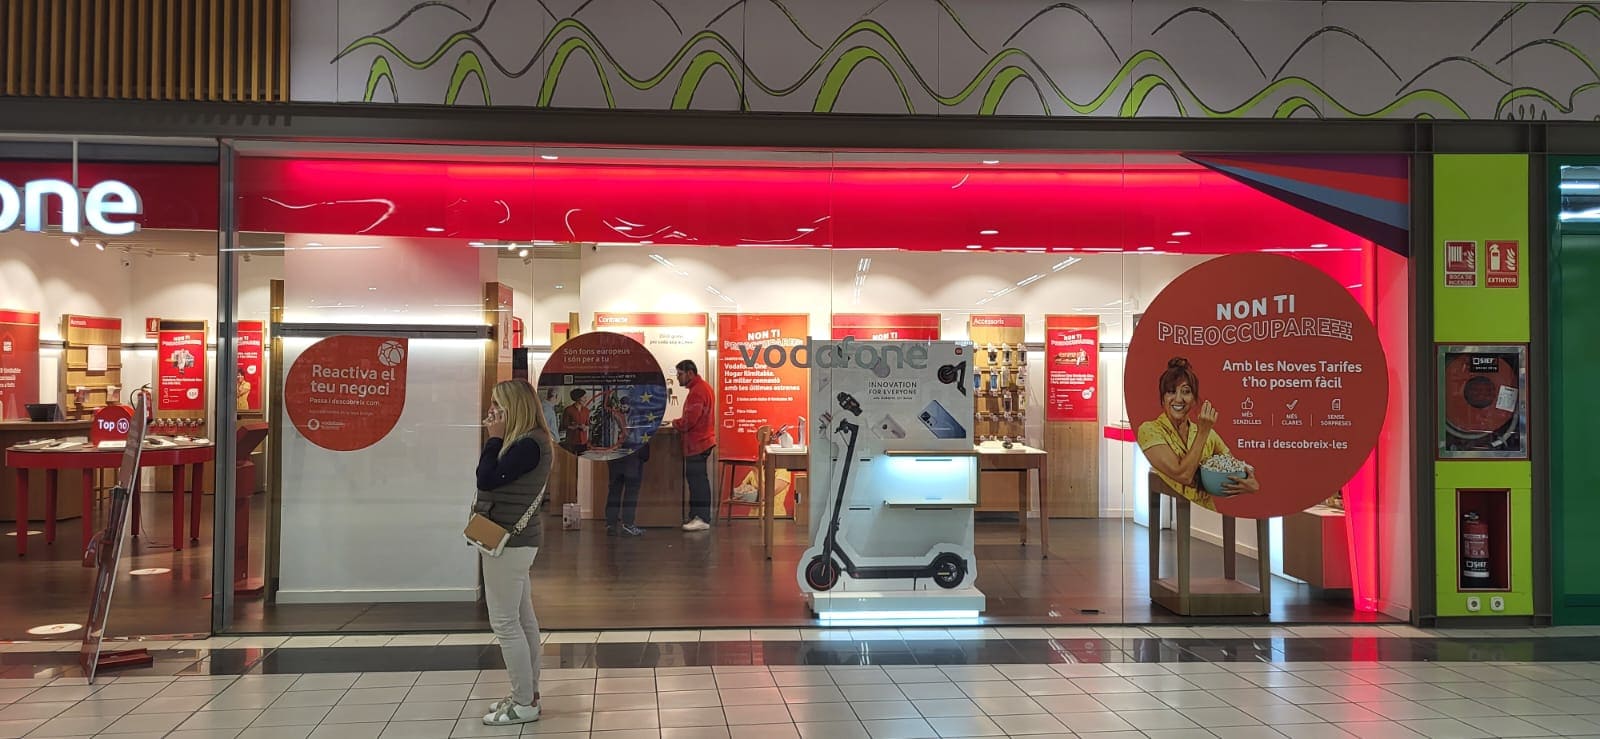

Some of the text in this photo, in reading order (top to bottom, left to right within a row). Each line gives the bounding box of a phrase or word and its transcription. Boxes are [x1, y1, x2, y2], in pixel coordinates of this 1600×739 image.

[1216, 294, 1295, 321] NON TI
[748, 329, 780, 341] NON TI
[739, 336, 928, 370] vodafone
[312, 364, 395, 381] Reactiva el
[1222, 360, 1362, 373] Amb les Noves Tarifes
[311, 380, 389, 397] teu negoci
[1270, 378, 1313, 390] posem
[1315, 376, 1342, 388] fàcil
[332, 398, 365, 406] descobreix
[98, 419, 115, 432] Top
[1237, 439, 1265, 449] Entra
[1273, 439, 1348, 449] descobreix-les
